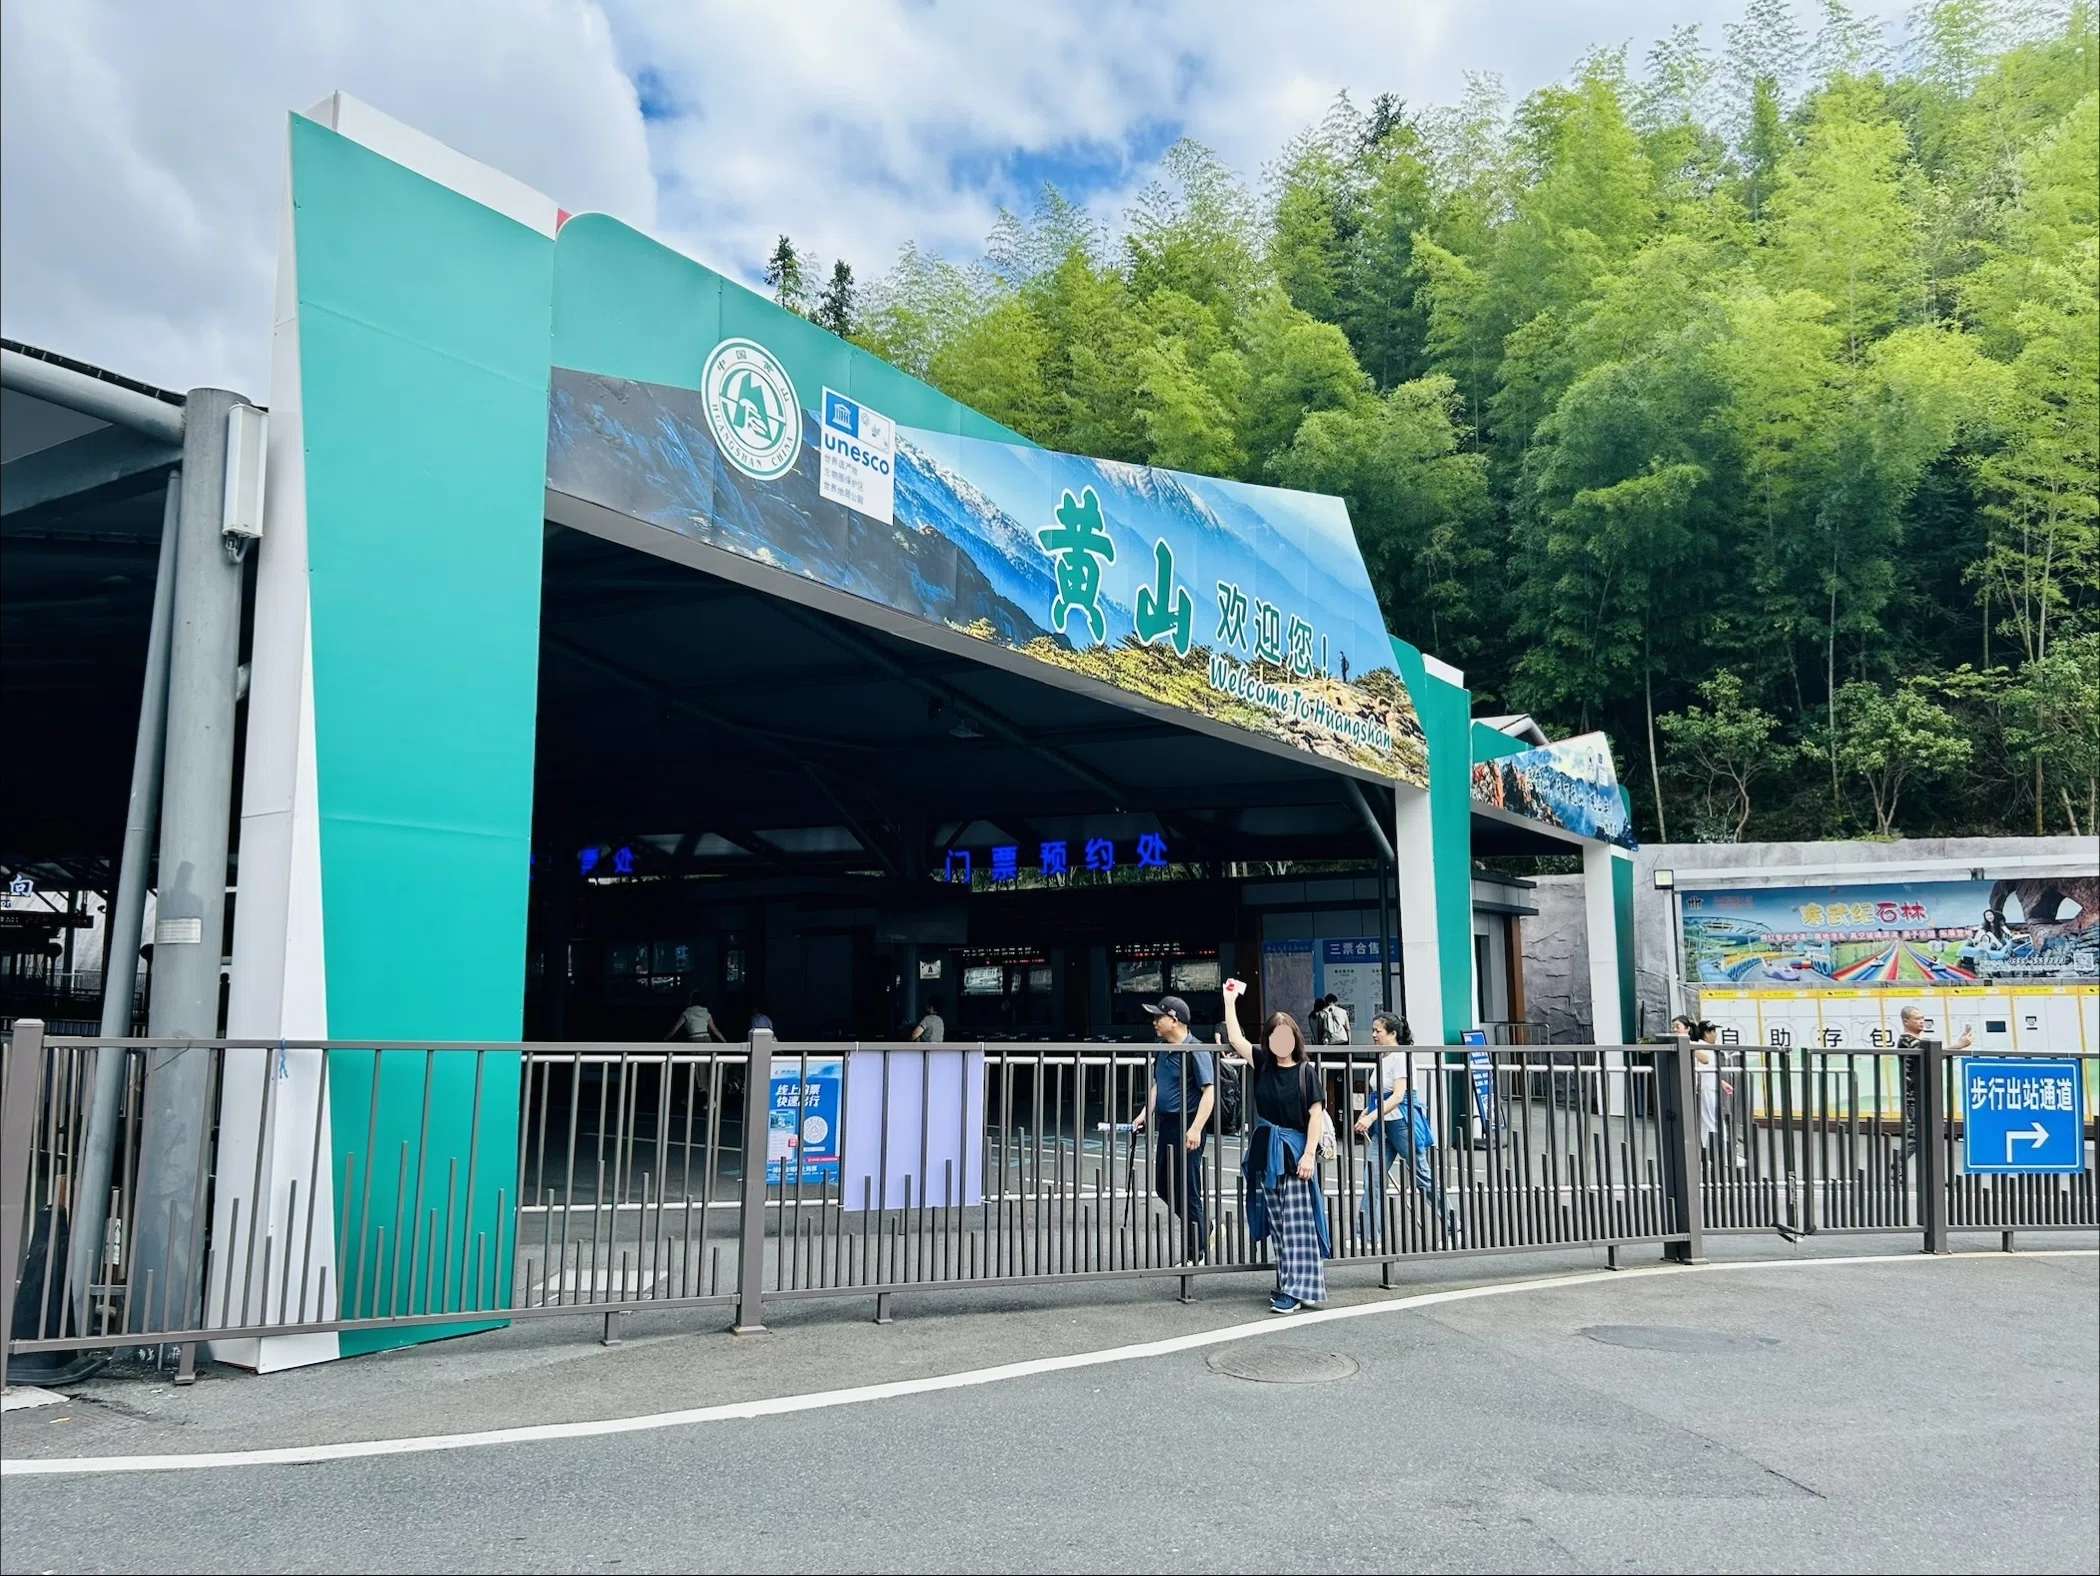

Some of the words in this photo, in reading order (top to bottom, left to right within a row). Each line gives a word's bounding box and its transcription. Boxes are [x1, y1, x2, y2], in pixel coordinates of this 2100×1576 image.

[716, 349, 791, 403] 中国黄山
[712, 403, 763, 469] HUANGSHAN
[771, 436, 794, 467] CHINA
[825, 432, 890, 475] unesco
[1037, 486, 1193, 657] 黄山
[1210, 655, 1289, 713] Welcome
[1293, 689, 1311, 721] To
[1314, 697, 1392, 750] Huangshan
[945, 832, 1168, 882] 门票预约处
[1800, 901, 1928, 926] 寒武纪石林
[1330, 941, 1396, 956] 三票合售
[1721, 1027, 1896, 1048] 自助存包
[1970, 1076, 2073, 1111] 步行出站通道
